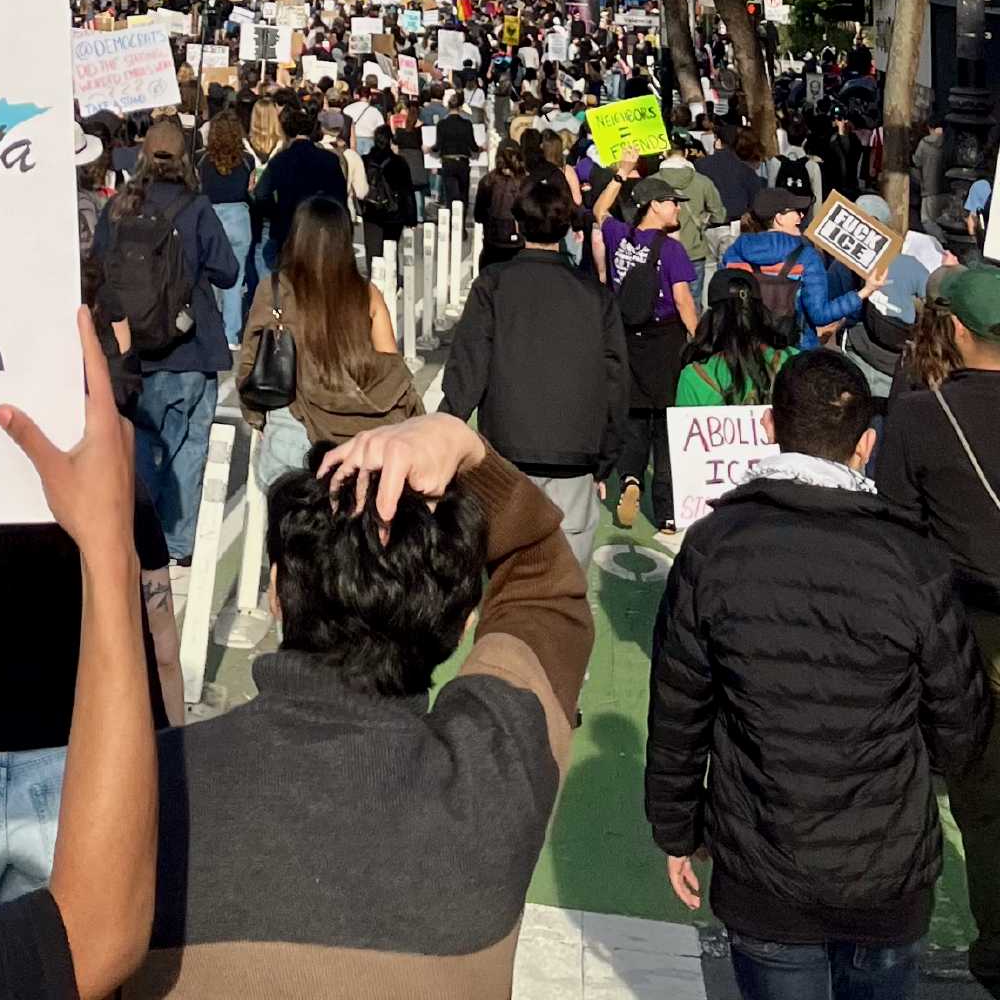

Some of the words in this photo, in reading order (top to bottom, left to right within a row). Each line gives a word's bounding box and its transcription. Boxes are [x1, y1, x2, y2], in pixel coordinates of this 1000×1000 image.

[595, 105, 657, 128] NEIGHBORS
[828, 226, 868, 261] ICE
[834, 208, 883, 251] FUCK
